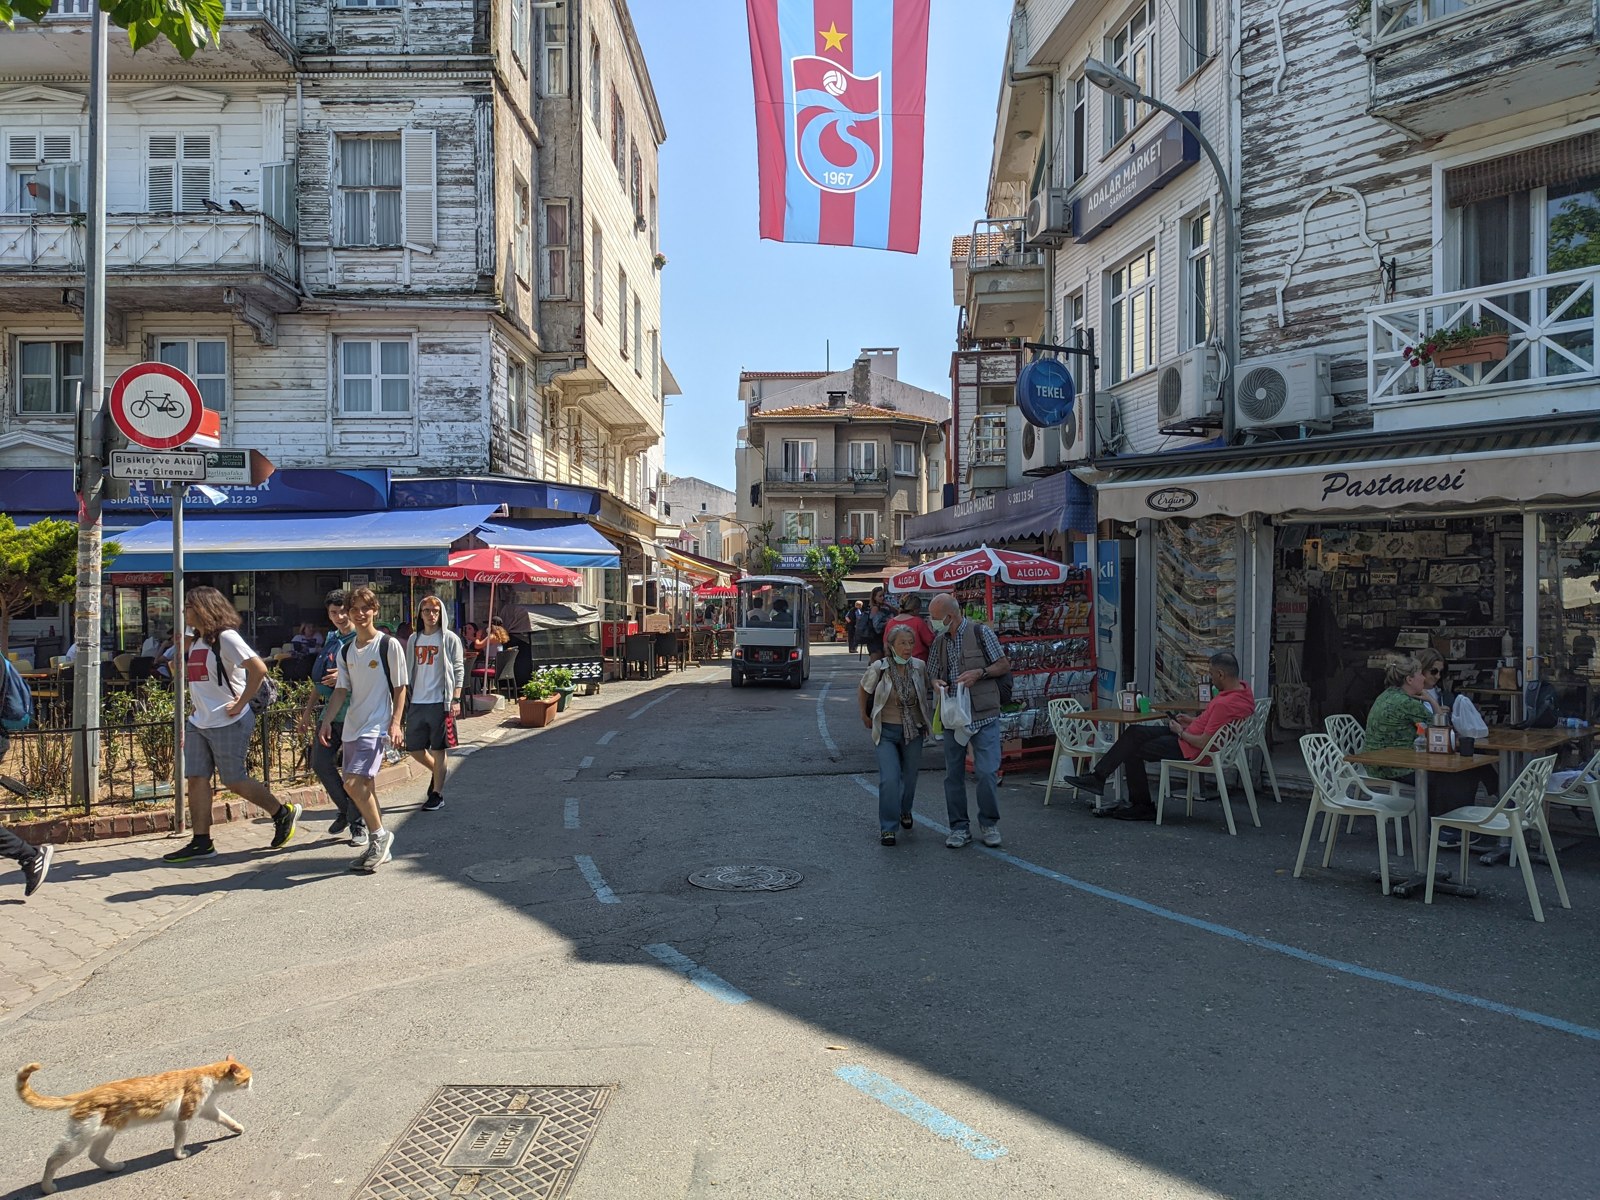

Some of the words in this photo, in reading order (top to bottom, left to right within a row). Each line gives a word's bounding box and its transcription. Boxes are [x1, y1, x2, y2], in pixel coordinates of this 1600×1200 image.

[823, 171, 854, 186] 1967
[1087, 174, 1121, 214] ADALAR
[1123, 139, 1162, 185] MARKET
[1036, 385, 1065, 399] TEKEL
[115, 455, 155, 465] Bisiklet
[159, 457, 170, 465] ve
[174, 457, 202, 466] Akülü
[125, 467, 149, 476] Araç
[153, 468, 194, 477] Giremez
[1322, 468, 1466, 501] Pastanesi
[231, 496, 243, 504] 12
[245, 496, 258, 504] 29
[953, 500, 974, 518] ADALAR
[974, 495, 996, 513] MARKET
[1157, 493, 1185, 508] Ergün
